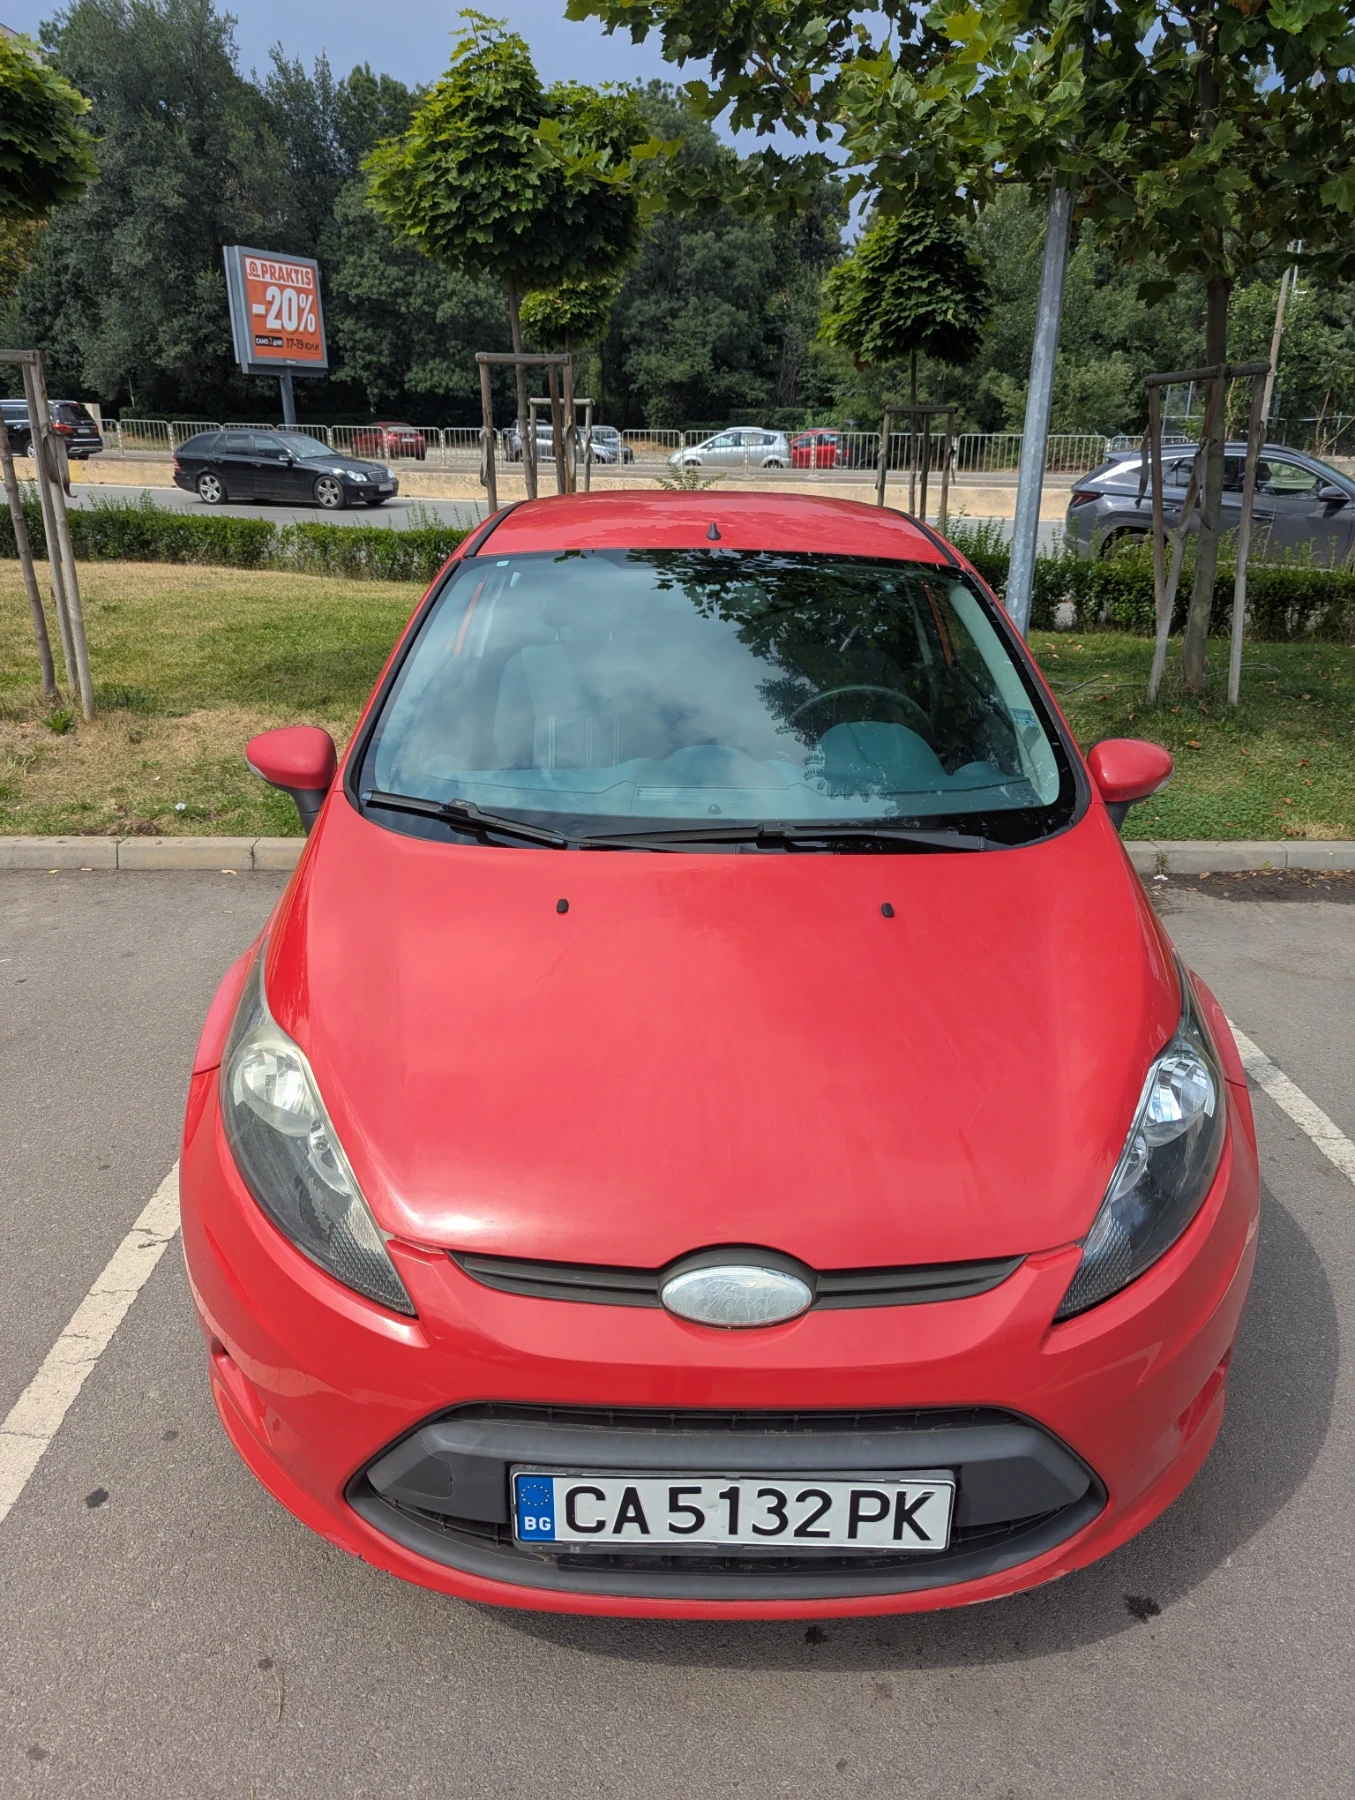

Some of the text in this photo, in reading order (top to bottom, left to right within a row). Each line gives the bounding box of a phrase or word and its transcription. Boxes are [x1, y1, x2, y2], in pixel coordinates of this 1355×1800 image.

[260, 262, 312, 287] PRAKTIS
[252, 286, 316, 333] -20%
[698, 1279, 778, 1311] Ford
[524, 1516, 552, 1531] BG
[565, 1485, 935, 1541] CA 5132 PK
